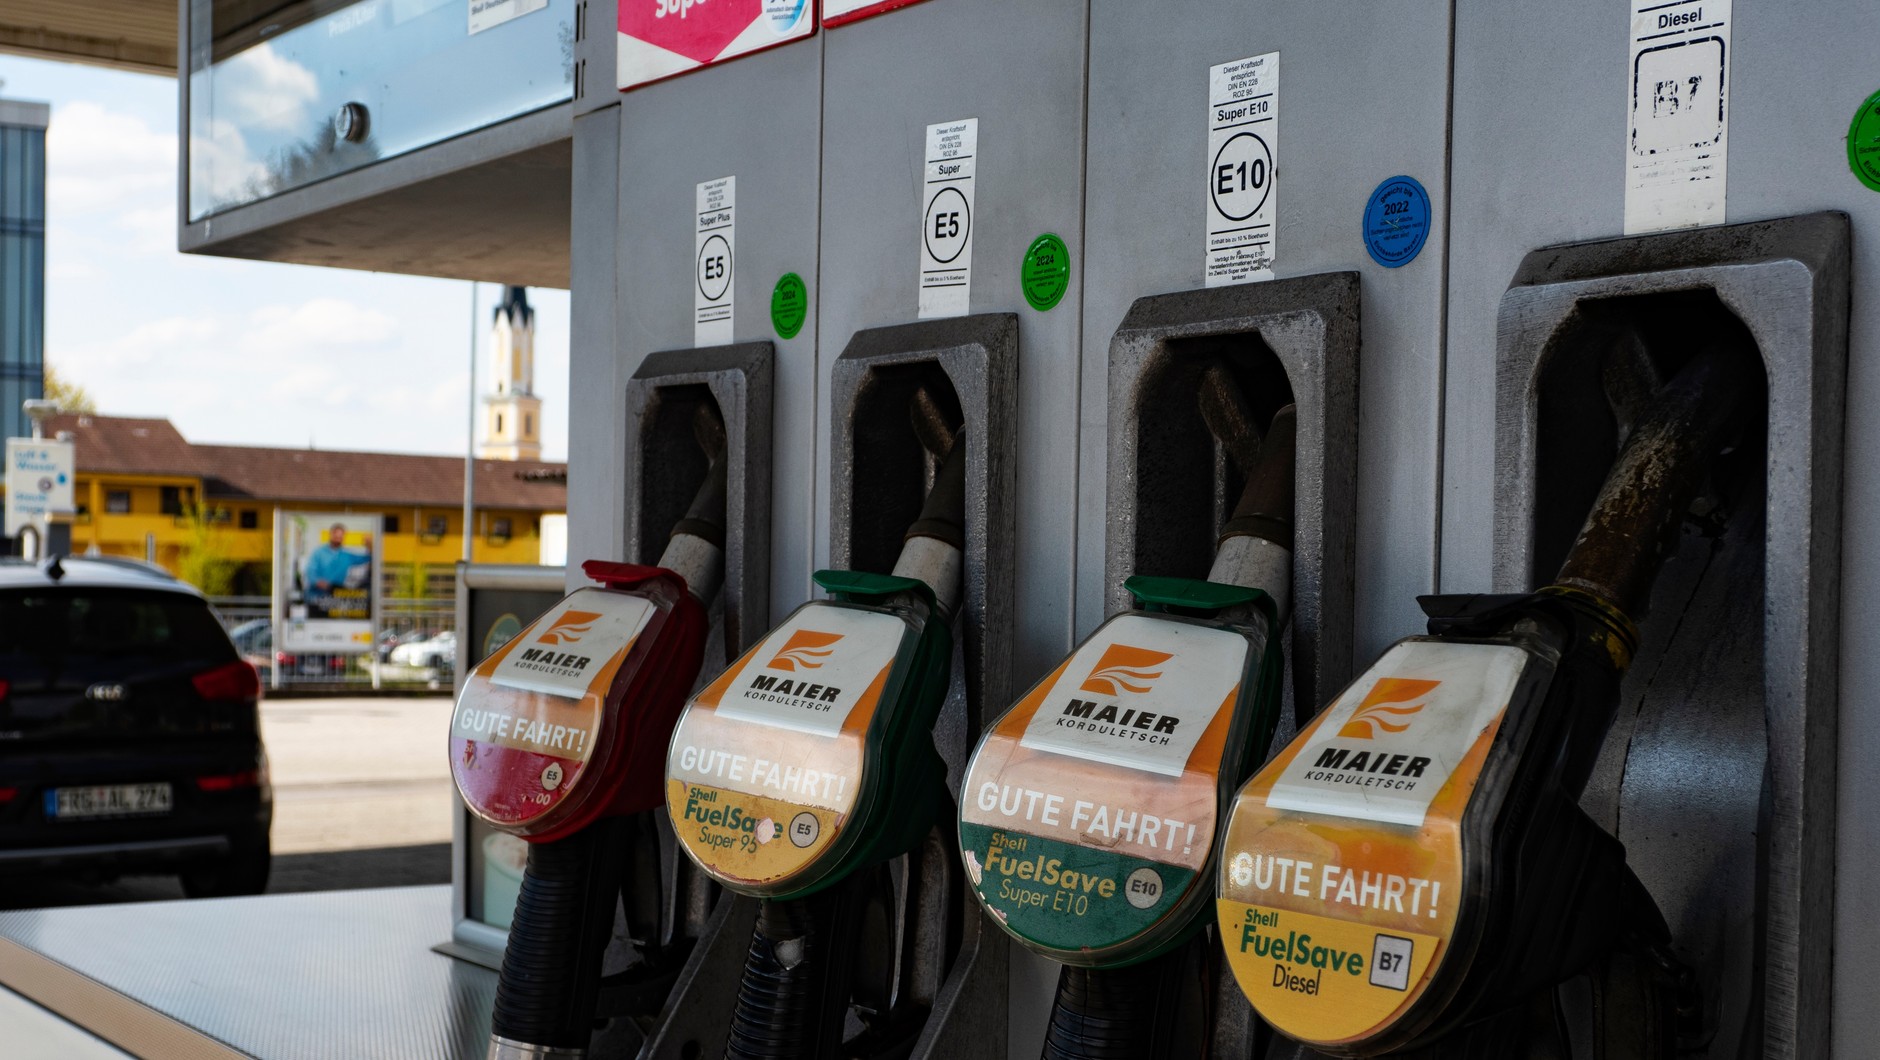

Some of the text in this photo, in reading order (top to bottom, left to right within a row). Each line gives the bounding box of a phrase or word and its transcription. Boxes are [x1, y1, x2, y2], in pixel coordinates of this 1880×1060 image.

[1658, 7, 1702, 29] Diesel
[1240, 59, 1264, 70] Kraftstoff
[1228, 82, 1238, 91] DIN
[1248, 78, 1258, 86] 228
[1230, 70, 1256, 82] entspricht
[1232, 88, 1253, 98] ROZ 95
[1218, 100, 1268, 122] Super E10
[938, 164, 960, 176] Super
[1218, 158, 1265, 195] E10
[1384, 200, 1409, 216] 2022
[700, 213, 730, 226] Super Plus
[934, 212, 959, 239] E5
[705, 256, 724, 280] E5
[1036, 254, 1054, 266] 2024
[514, 662, 581, 678] KORDULETSCH
[520, 648, 591, 670] MAIER
[750, 674, 841, 702] MAIER
[744, 690, 832, 712] KORDULETSCH
[1062, 698, 1180, 735] MAIER
[460, 708, 586, 752] GUTE FAHRT!
[1056, 718, 1171, 746] KORDULETSCH
[680, 745, 846, 800] GUTE FAHRT!
[1314, 748, 1431, 778] MAIER
[546, 770, 558, 781] E5
[1304, 771, 1416, 791] KORDULETSCH
[690, 787, 717, 803] Shell
[684, 798, 784, 839] FuelSae
[977, 781, 1197, 855] GUTE FAHRT!
[699, 826, 758, 854] Super 95
[797, 823, 812, 836] E5
[991, 832, 1028, 852] Shell
[984, 846, 1116, 898] FuelSave
[1131, 879, 1157, 896] E10
[1233, 852, 1441, 918] GUTE FAHRT!
[999, 878, 1089, 916] Super E10
[1245, 908, 1278, 928] Shell
[1240, 924, 1364, 976] FuelSave
[1379, 952, 1403, 973] B7
[1272, 964, 1321, 995] Diesel
